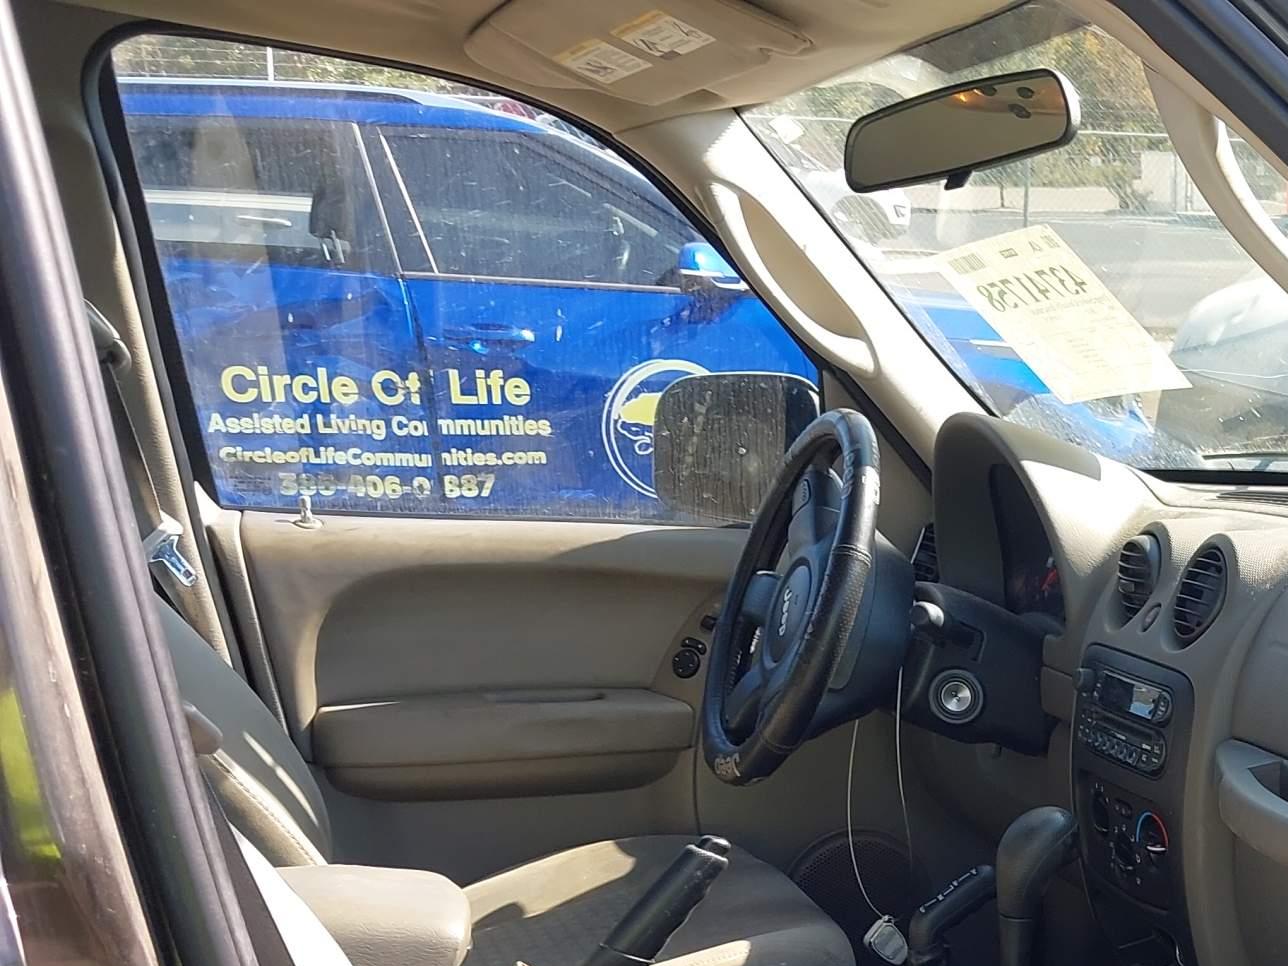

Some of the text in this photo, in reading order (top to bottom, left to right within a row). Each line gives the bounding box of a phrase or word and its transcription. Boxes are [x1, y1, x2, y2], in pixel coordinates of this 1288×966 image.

[220, 366, 531, 406] Circle Of Life
[208, 413, 311, 435] Assisted
[317, 413, 386, 440] Living
